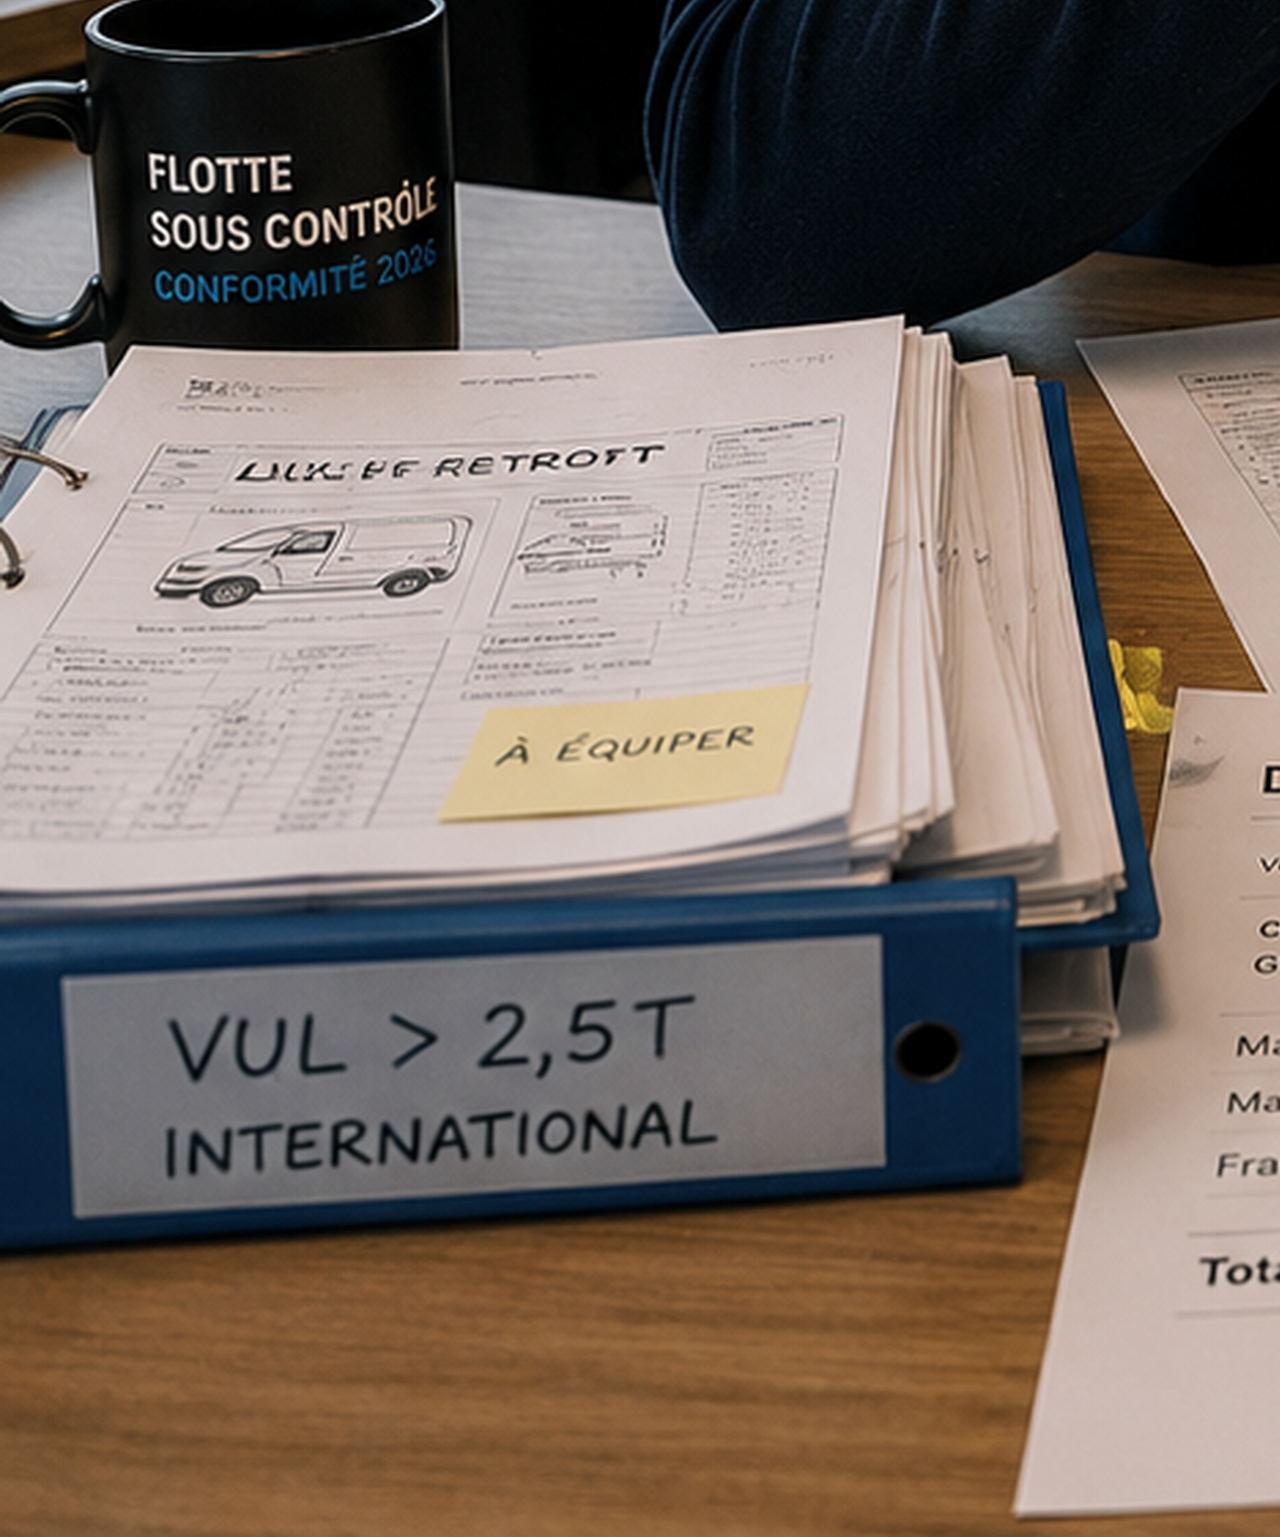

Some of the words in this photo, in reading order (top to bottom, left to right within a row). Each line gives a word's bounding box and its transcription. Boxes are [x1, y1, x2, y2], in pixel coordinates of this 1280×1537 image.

[149, 153, 292, 193] FLOTTE
[151, 211, 250, 251] SOUS
[265, 176, 438, 249] CONTRÔLE
[155, 255, 366, 303] CONFORMITÉ
[377, 239, 435, 285] 2026
[495, 736, 529, 766] À
[556, 726, 754, 762] ÉQUIPER
[169, 1014, 347, 1083] VUL
[166, 1100, 717, 1179] INTERNATIONAL
